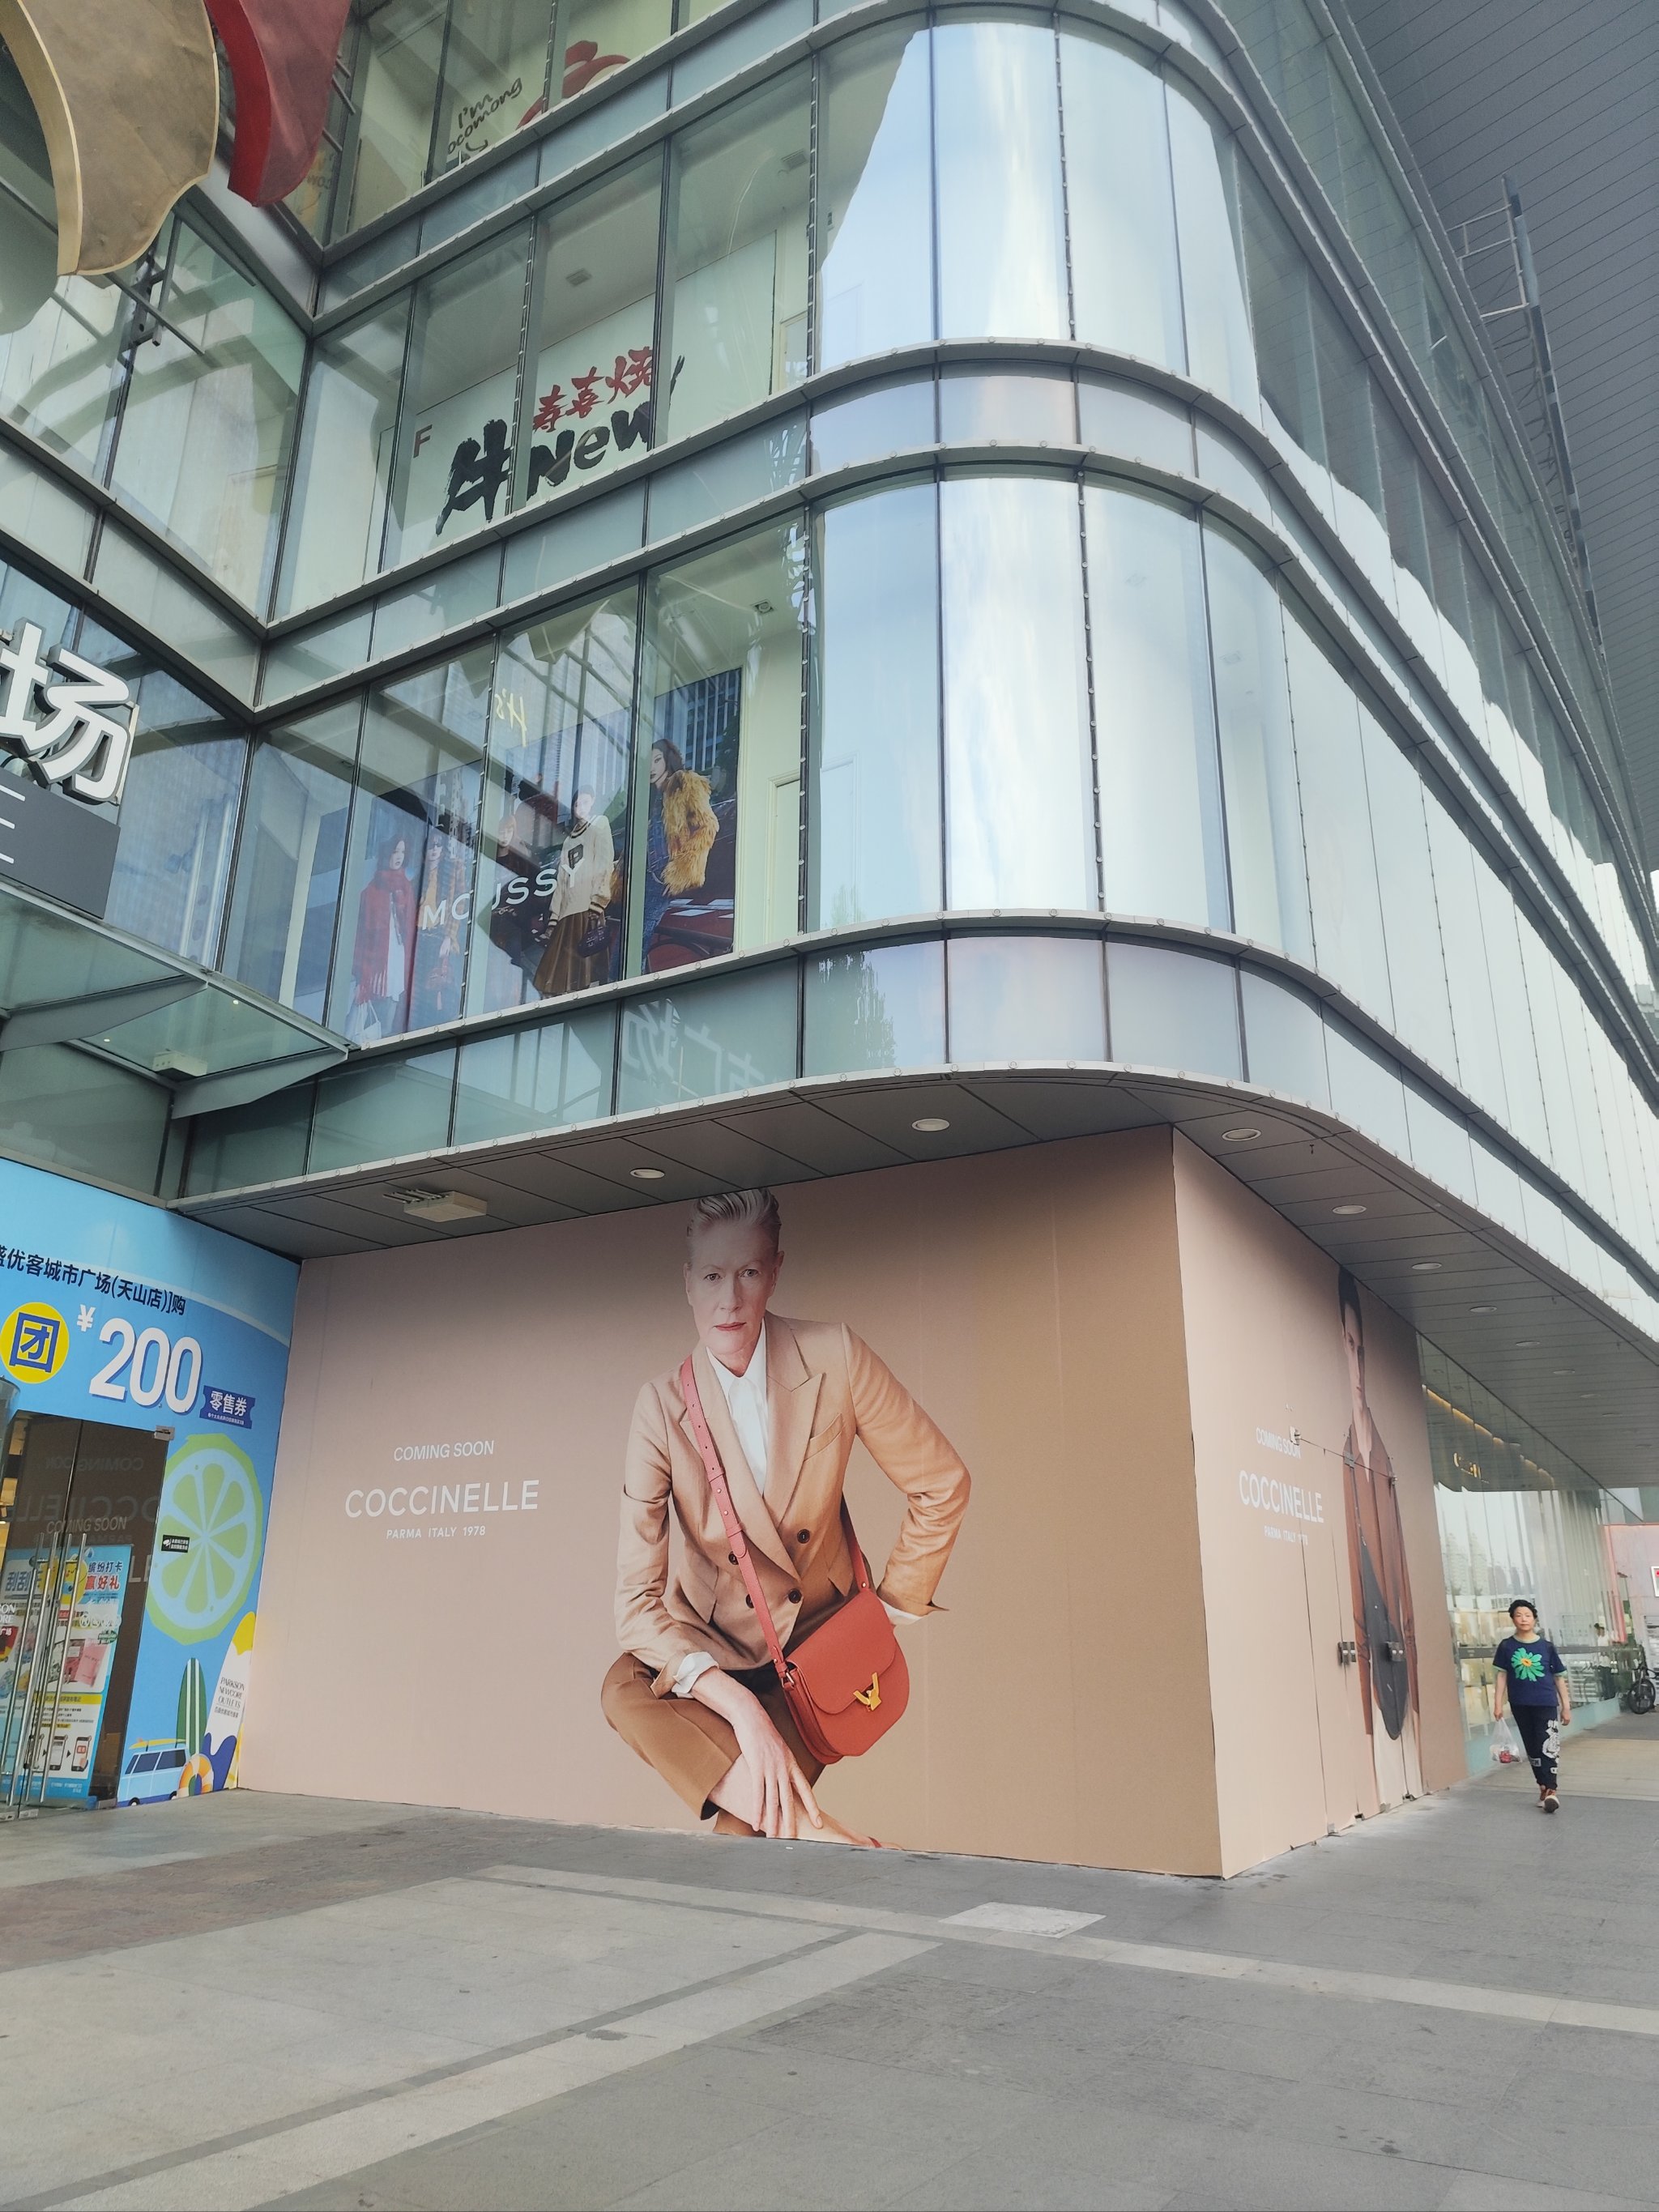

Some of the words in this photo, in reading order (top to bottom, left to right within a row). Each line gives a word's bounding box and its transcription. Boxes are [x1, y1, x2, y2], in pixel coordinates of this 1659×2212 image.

[0, 620, 133, 802] 场
[9, 1312, 61, 1374] 团
[210, 1390, 247, 1417] 零售券
[394, 1443, 450, 1462] COMING
[453, 1440, 494, 1458] SOON
[345, 1479, 539, 1518] COCCINELLE
[1239, 1469, 1324, 1524] COCCINELLE
[386, 1528, 422, 1540] PARMA
[428, 1527, 457, 1538] ITALY
[463, 1525, 486, 1536] 1978
[88, 1562, 123, 1573] 缤纷打卡
